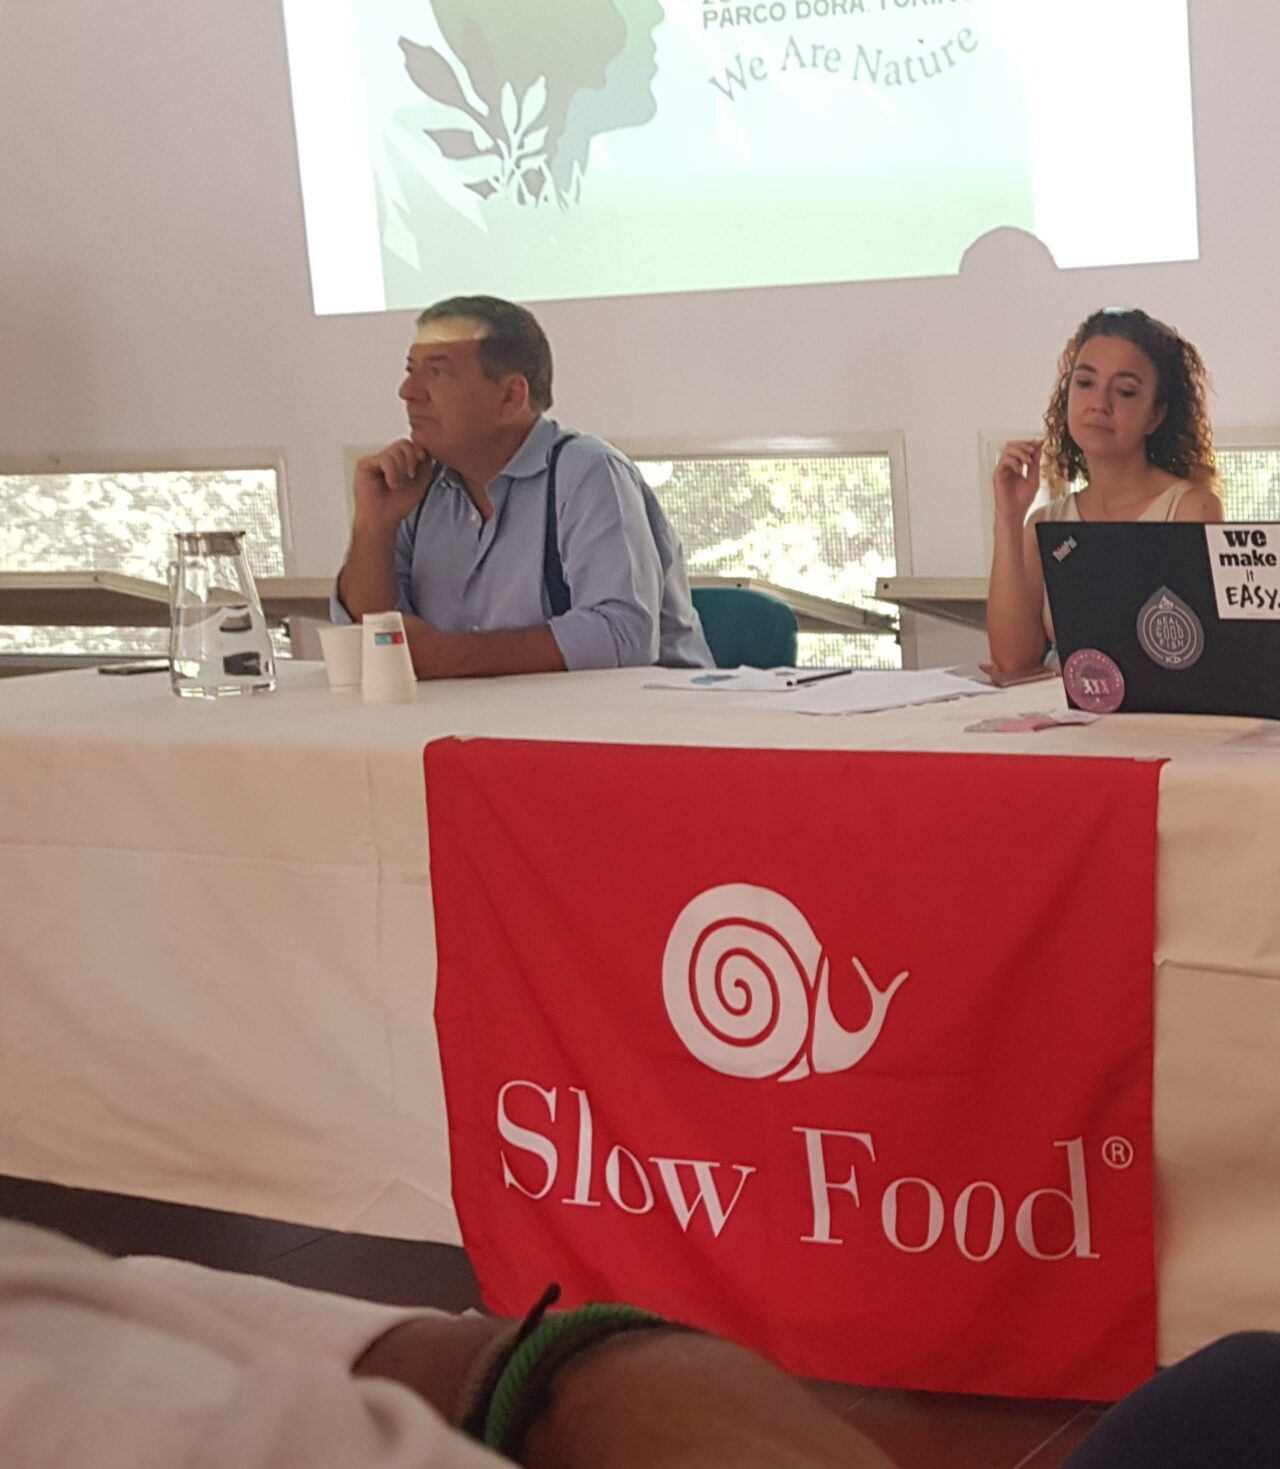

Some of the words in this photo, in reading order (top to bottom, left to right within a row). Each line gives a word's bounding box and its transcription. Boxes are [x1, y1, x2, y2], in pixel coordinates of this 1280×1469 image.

[702, 2, 787, 30] PARCO
[708, 53, 768, 101] We
[781, 35, 842, 73] Are
[852, 28, 979, 86] Nature
[1223, 530, 1267, 548] we
[1219, 549, 1277, 567] make
[495, 1079, 757, 1239] Slow
